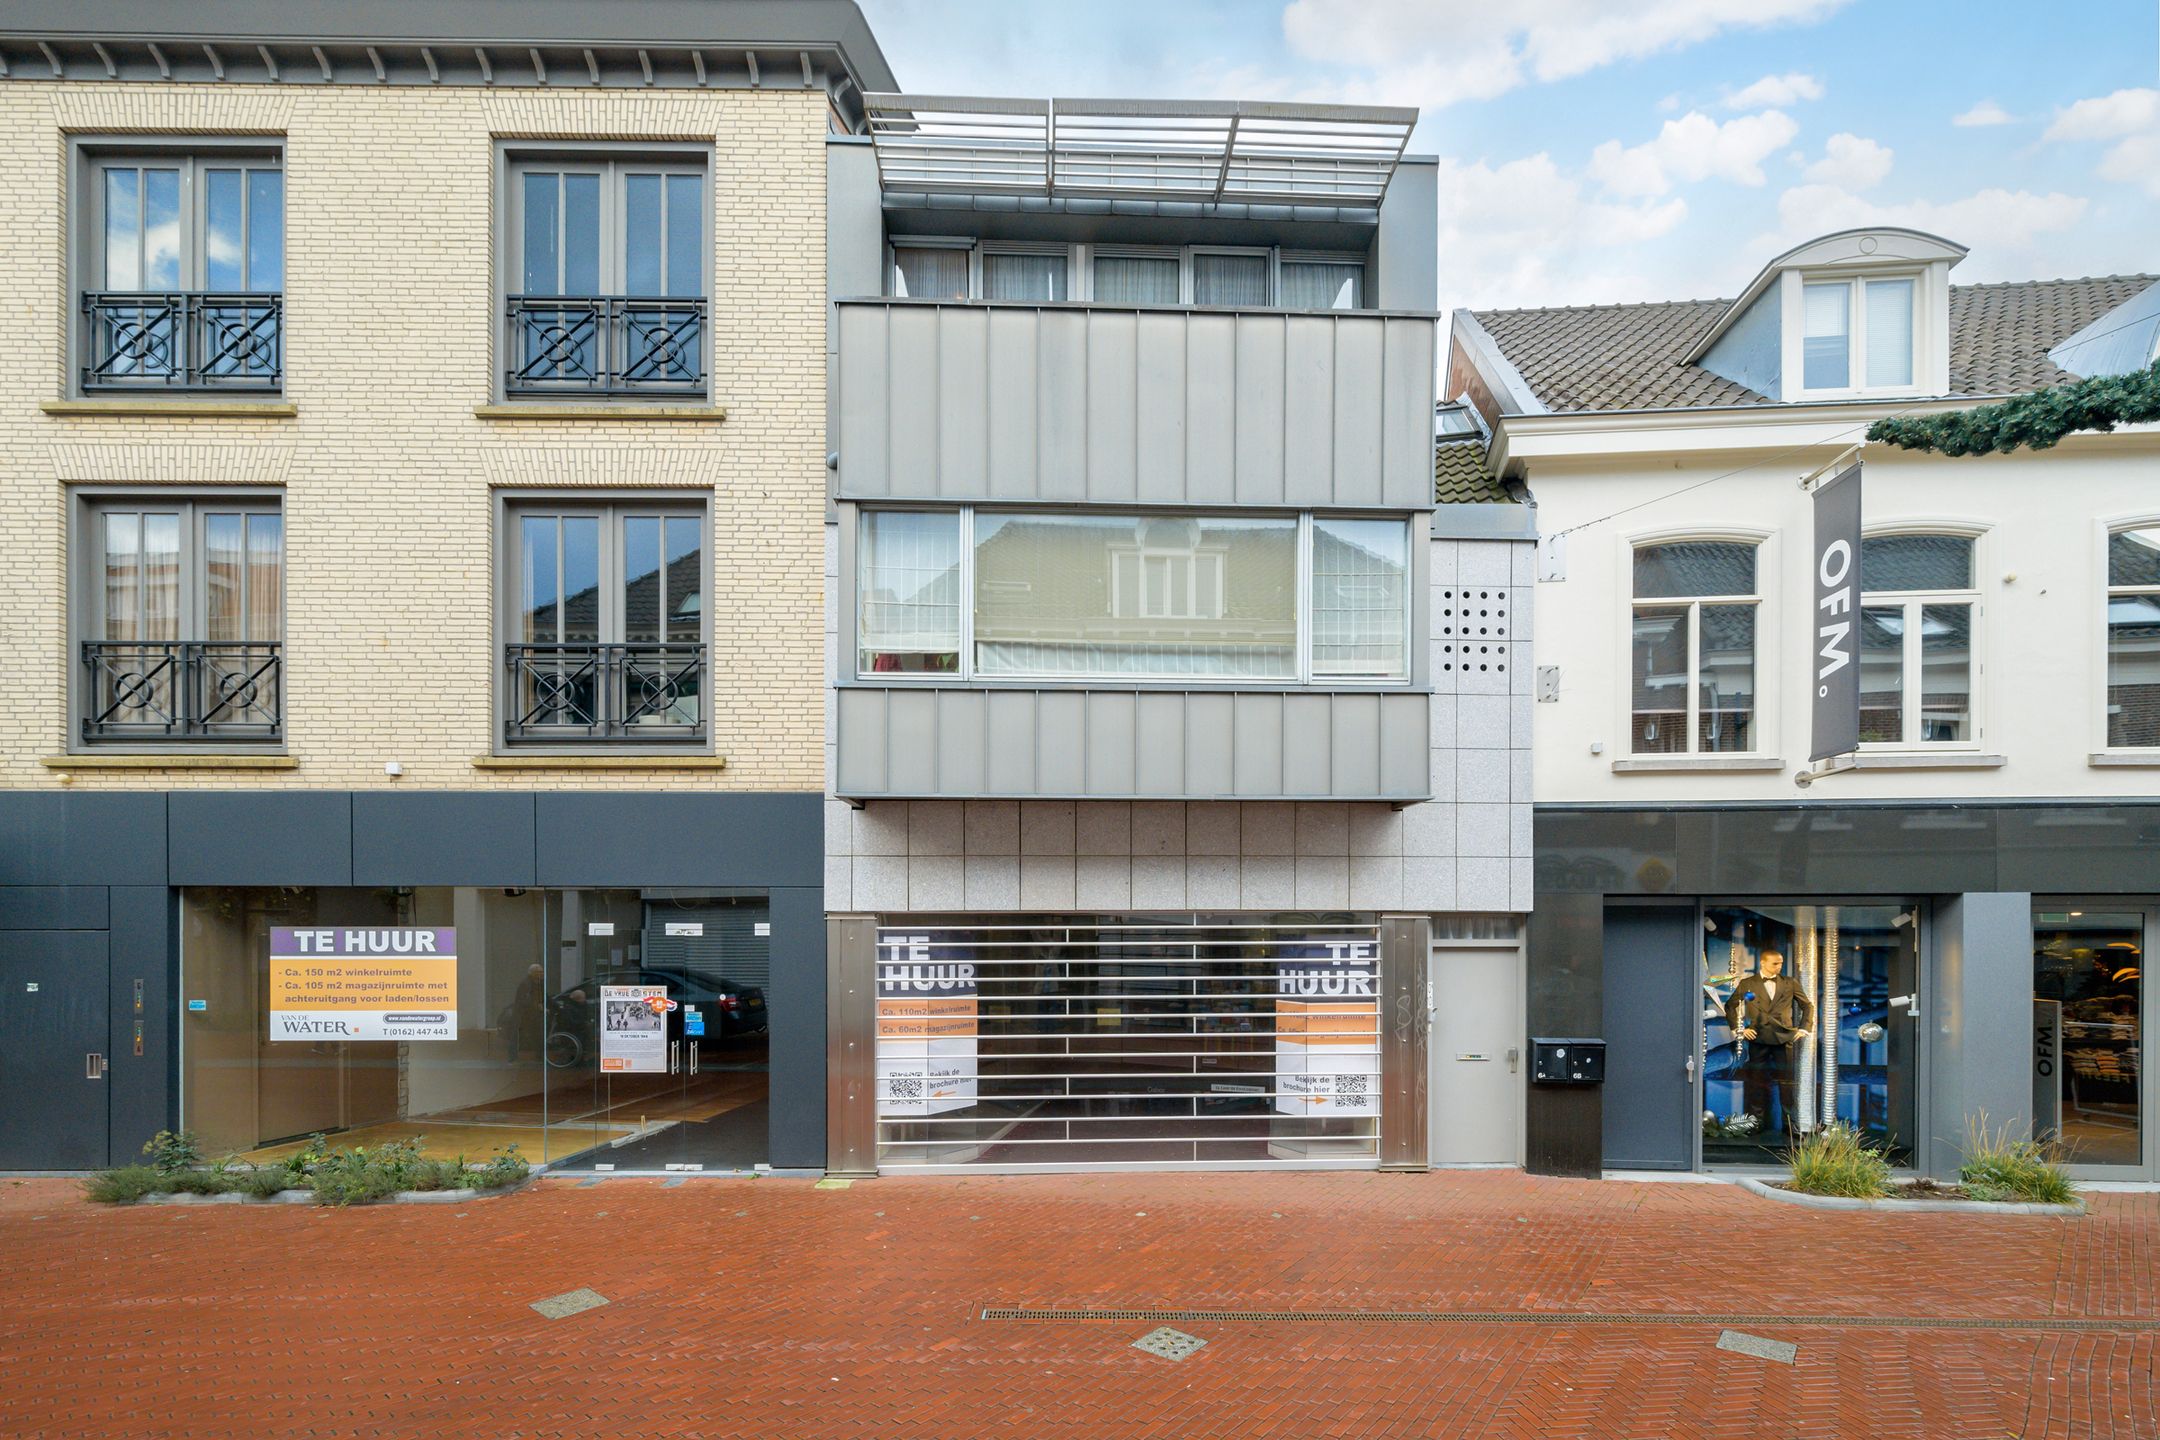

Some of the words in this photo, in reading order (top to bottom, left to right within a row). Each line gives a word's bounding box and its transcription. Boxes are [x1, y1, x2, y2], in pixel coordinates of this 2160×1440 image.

[293, 930, 334, 952] TE
[345, 930, 436, 952] HUUR
[883, 936, 930, 961] TE
[1325, 943, 1371, 966] TE
[285, 968, 302, 976] Ca.
[305, 968, 323, 976] 150
[326, 968, 342, 976] m2
[345, 968, 412, 976] winkelruimte
[885, 963, 976, 991] HUUR
[285, 981, 302, 989] Ca.
[305, 981, 323, 989] 105
[326, 981, 342, 989] m2
[345, 981, 424, 991] magazijnruimte
[1279, 968, 1372, 995] HUUR
[285, 994, 357, 1004] achteruitgang
[385, 994, 449, 1003] laden/lossen
[882, 1008, 896, 1016] Ca.
[284, 1021, 351, 1036] WATER
[389, 1028, 415, 1036] (0162)
[1314, 1085, 1330, 1093] hier
